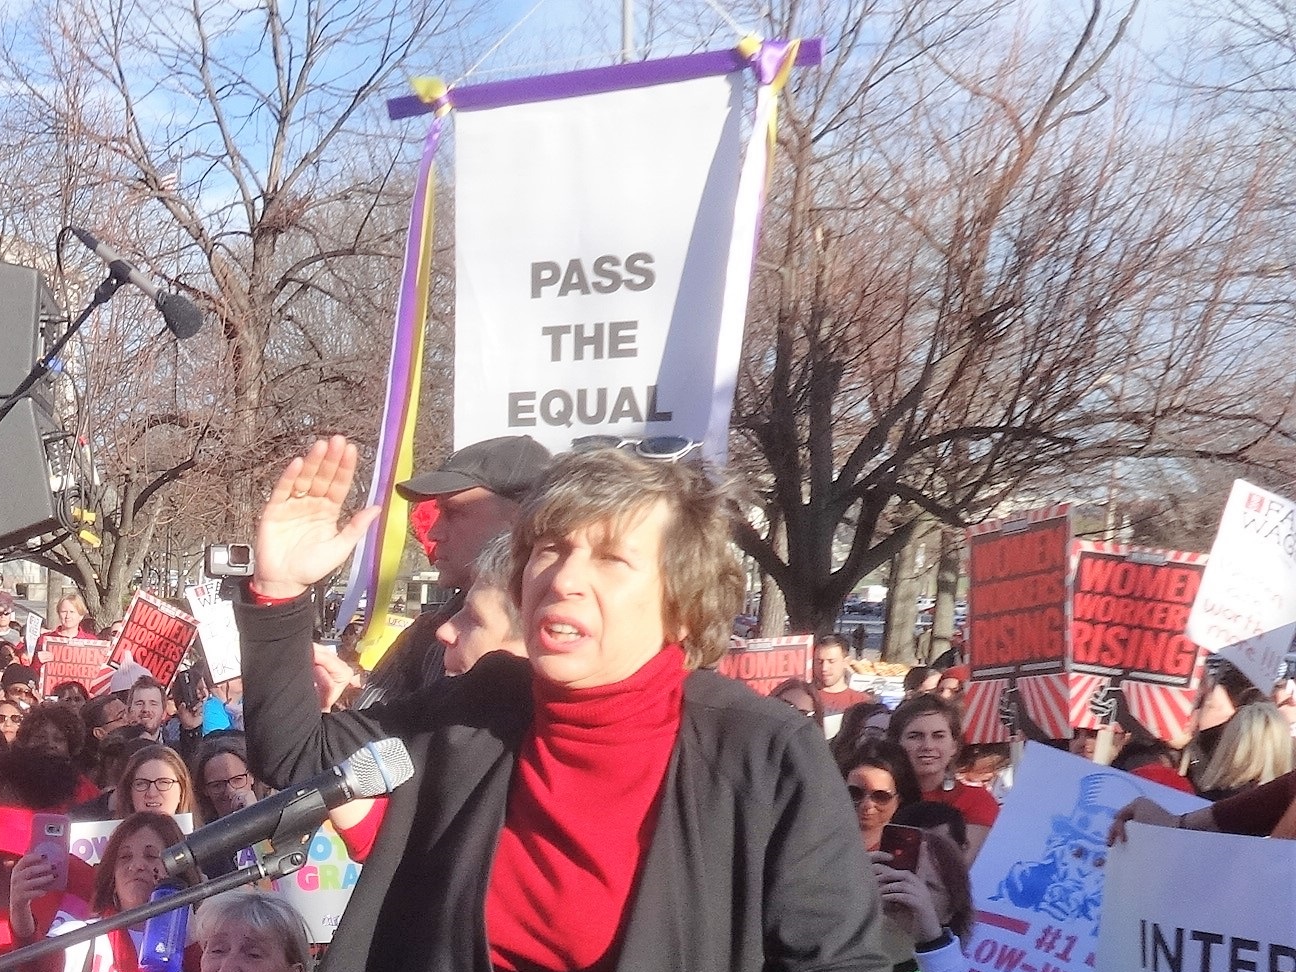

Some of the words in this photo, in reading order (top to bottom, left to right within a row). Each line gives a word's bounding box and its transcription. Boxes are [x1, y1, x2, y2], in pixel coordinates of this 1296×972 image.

[530, 252, 656, 300] PASS
[541, 319, 639, 363] THE
[506, 383, 673, 429] EQUAL
[131, 601, 193, 646] WOMEN
[1073, 592, 1191, 632] WORKER
[52, 645, 104, 662] WOMEN
[124, 621, 185, 663] WORKERS
[1071, 620, 1198, 676] RISING
[719, 648, 807, 680] WOMEN
[1034, 925, 1079, 964] #1
